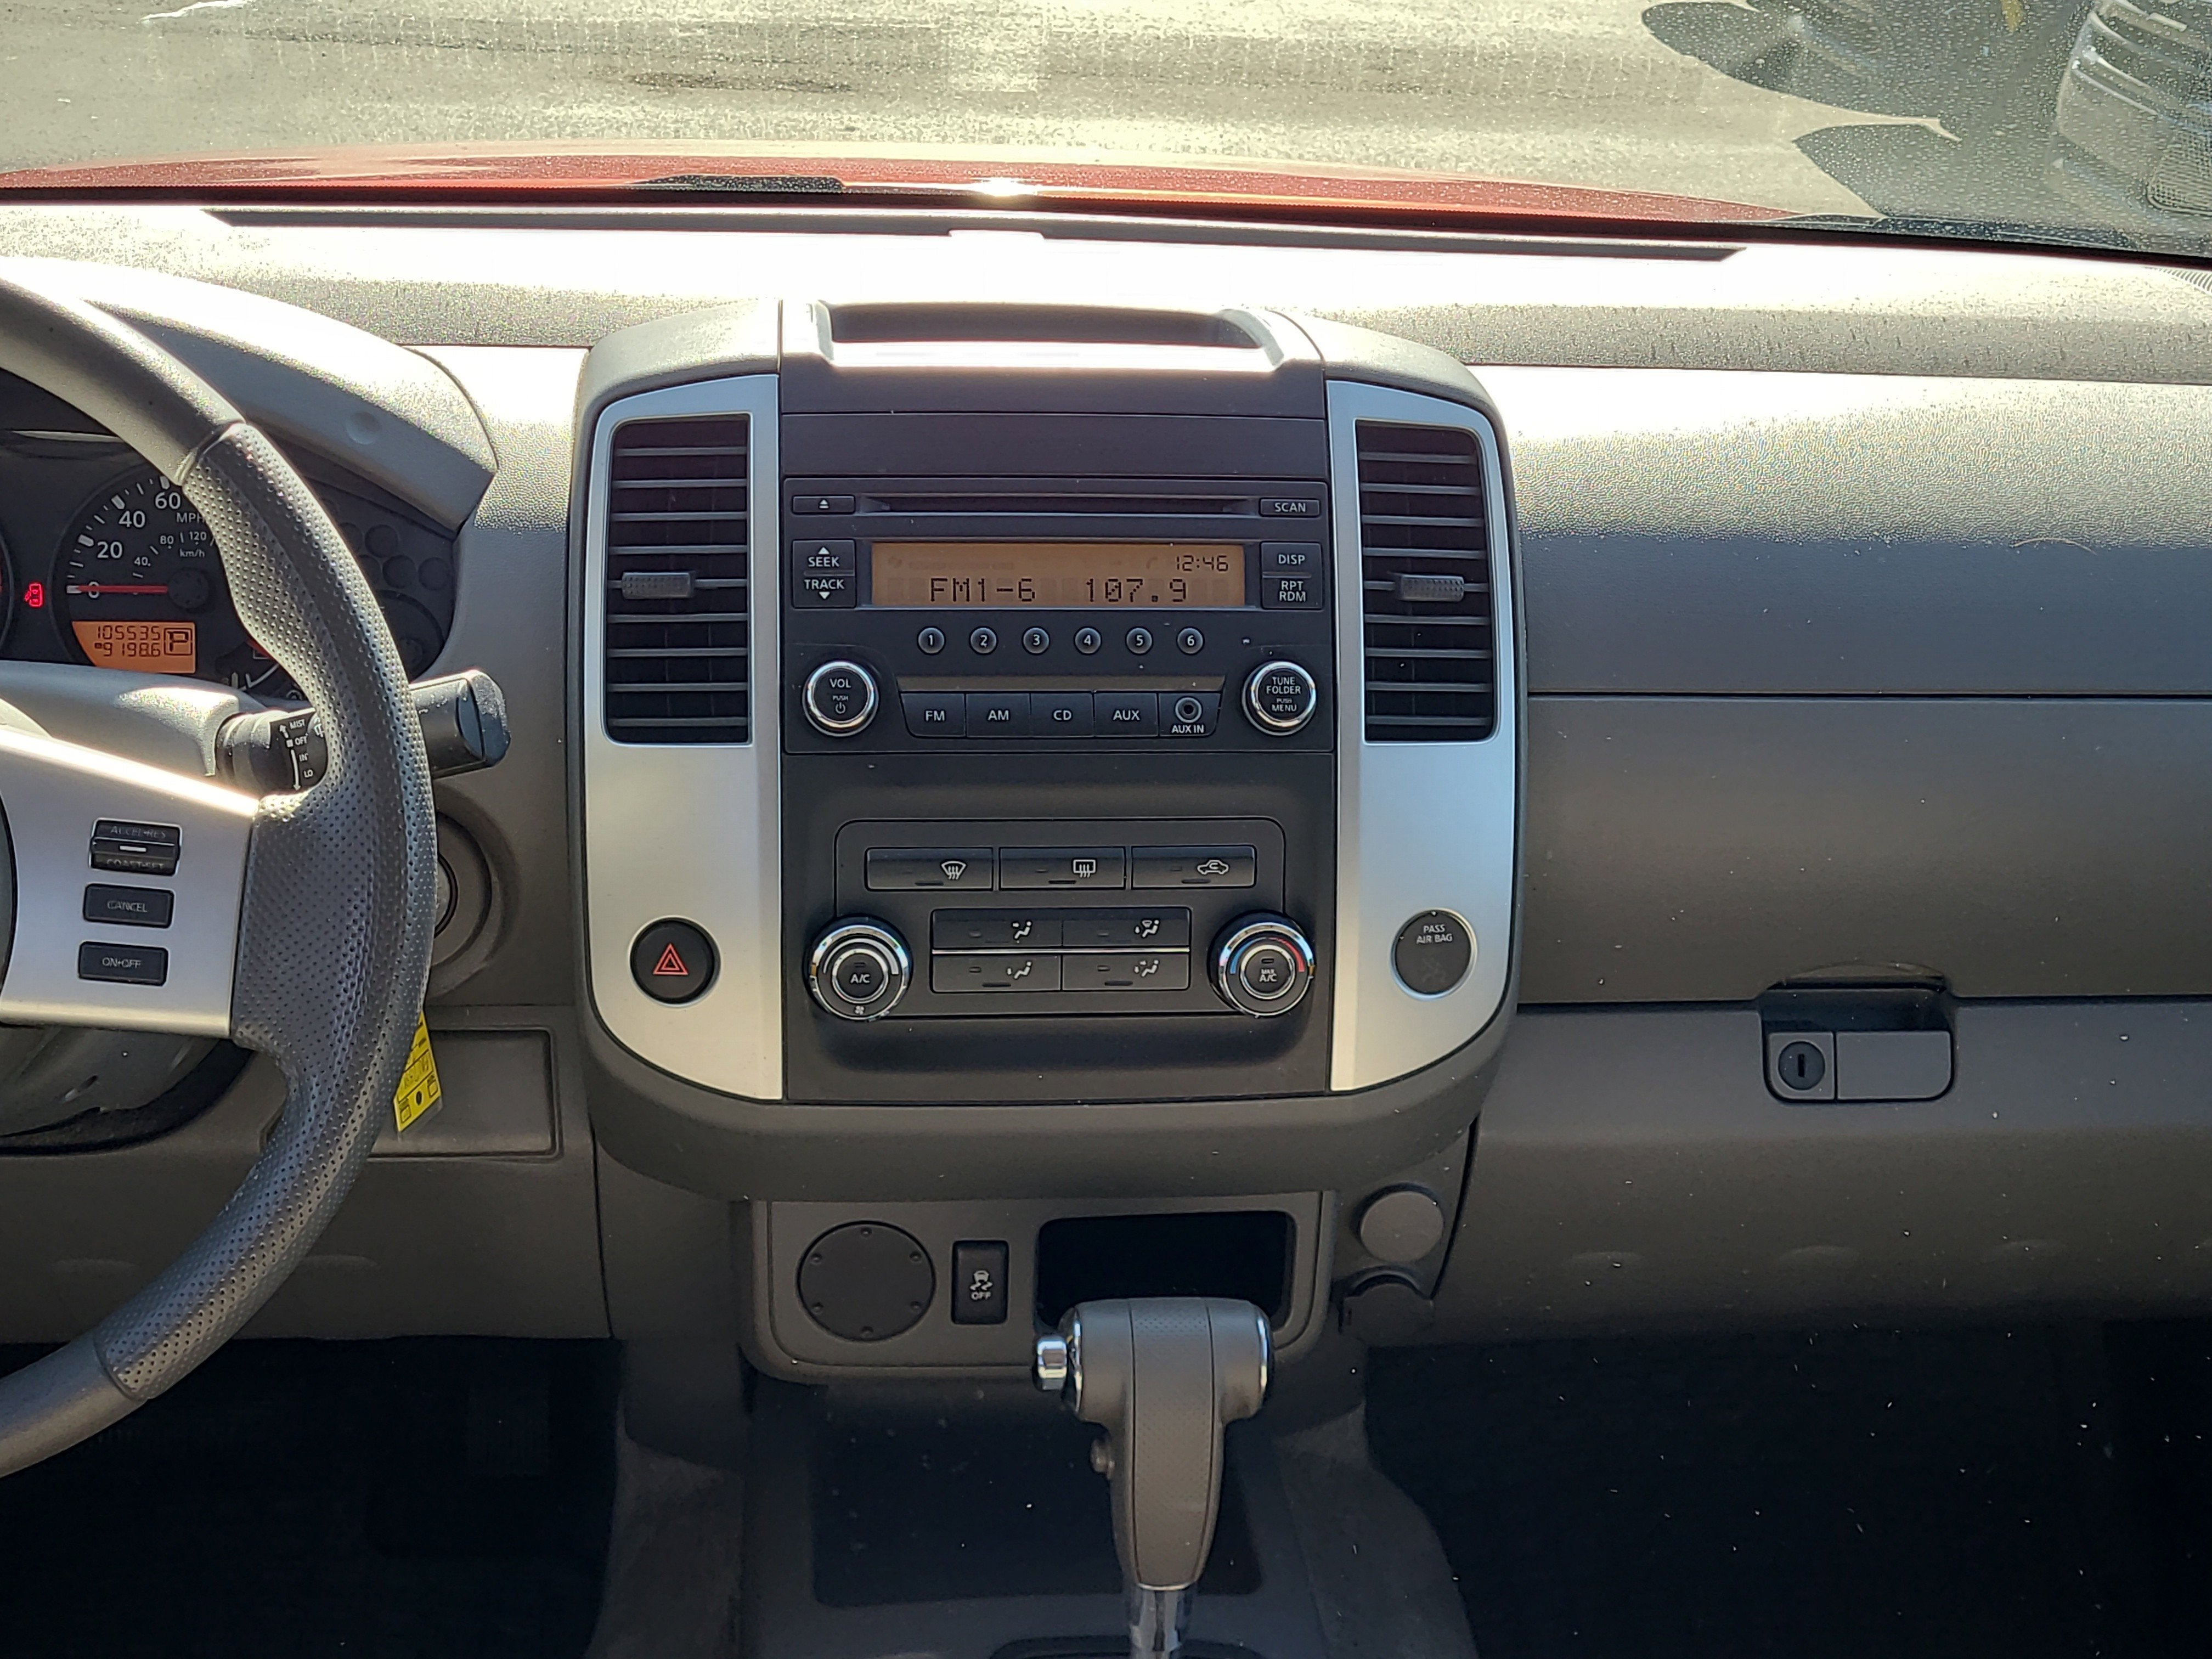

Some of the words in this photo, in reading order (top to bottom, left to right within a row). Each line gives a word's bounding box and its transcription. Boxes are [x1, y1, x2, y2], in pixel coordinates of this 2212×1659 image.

[155, 492, 181, 509] 60
[1274, 503, 1306, 513] SCAN
[119, 511, 145, 528] 40
[177, 512, 205, 523] MPH
[160, 535, 174, 544] 80
[189, 531, 207, 540] 120
[97, 541, 123, 558] 20
[180, 549, 205, 557] km/h
[134, 557, 148, 566] 40
[808, 556, 840, 567] SEEK
[1176, 555, 1228, 572] 12:46
[1278, 554, 1306, 565] DISP
[804, 579, 845, 590] TRACK
[930, 578, 1036, 602] FM1-6
[1086, 578, 1186, 602] 107.9
[1281, 581, 1304, 591] RPT
[1279, 592, 1306, 602] RDM
[98, 625, 160, 640] 105535
[167, 631, 189, 652] P
[928, 635, 934, 646] 1
[980, 635, 988, 647] 2
[1033, 635, 1040, 646] 3
[1084, 635, 1092, 646] 4
[1136, 635, 1143, 646] 5
[1187, 635, 1195, 646] 6
[830, 678, 851, 688] VOL
[1272, 676, 1295, 685] TUNE
[1266, 685, 1301, 695] FOLDER
[925, 711, 945, 721] FM
[988, 710, 1009, 721] AM
[1053, 710, 1072, 721] CD
[1113, 710, 1141, 720] AUX
[290, 719, 305, 729] MIST
[1171, 724, 1193, 734] AUX
[1194, 724, 1204, 734] IN
[303, 769, 314, 778] LO
[107, 900, 148, 913] CANCEL
[1423, 924, 1446, 933] PASS
[1416, 935, 1432, 945] AIR
[1435, 933, 1453, 943] BAG
[850, 974, 870, 984] A/C
[1259, 974, 1277, 982] A/C
[970, 1291, 991, 1300] OFF
